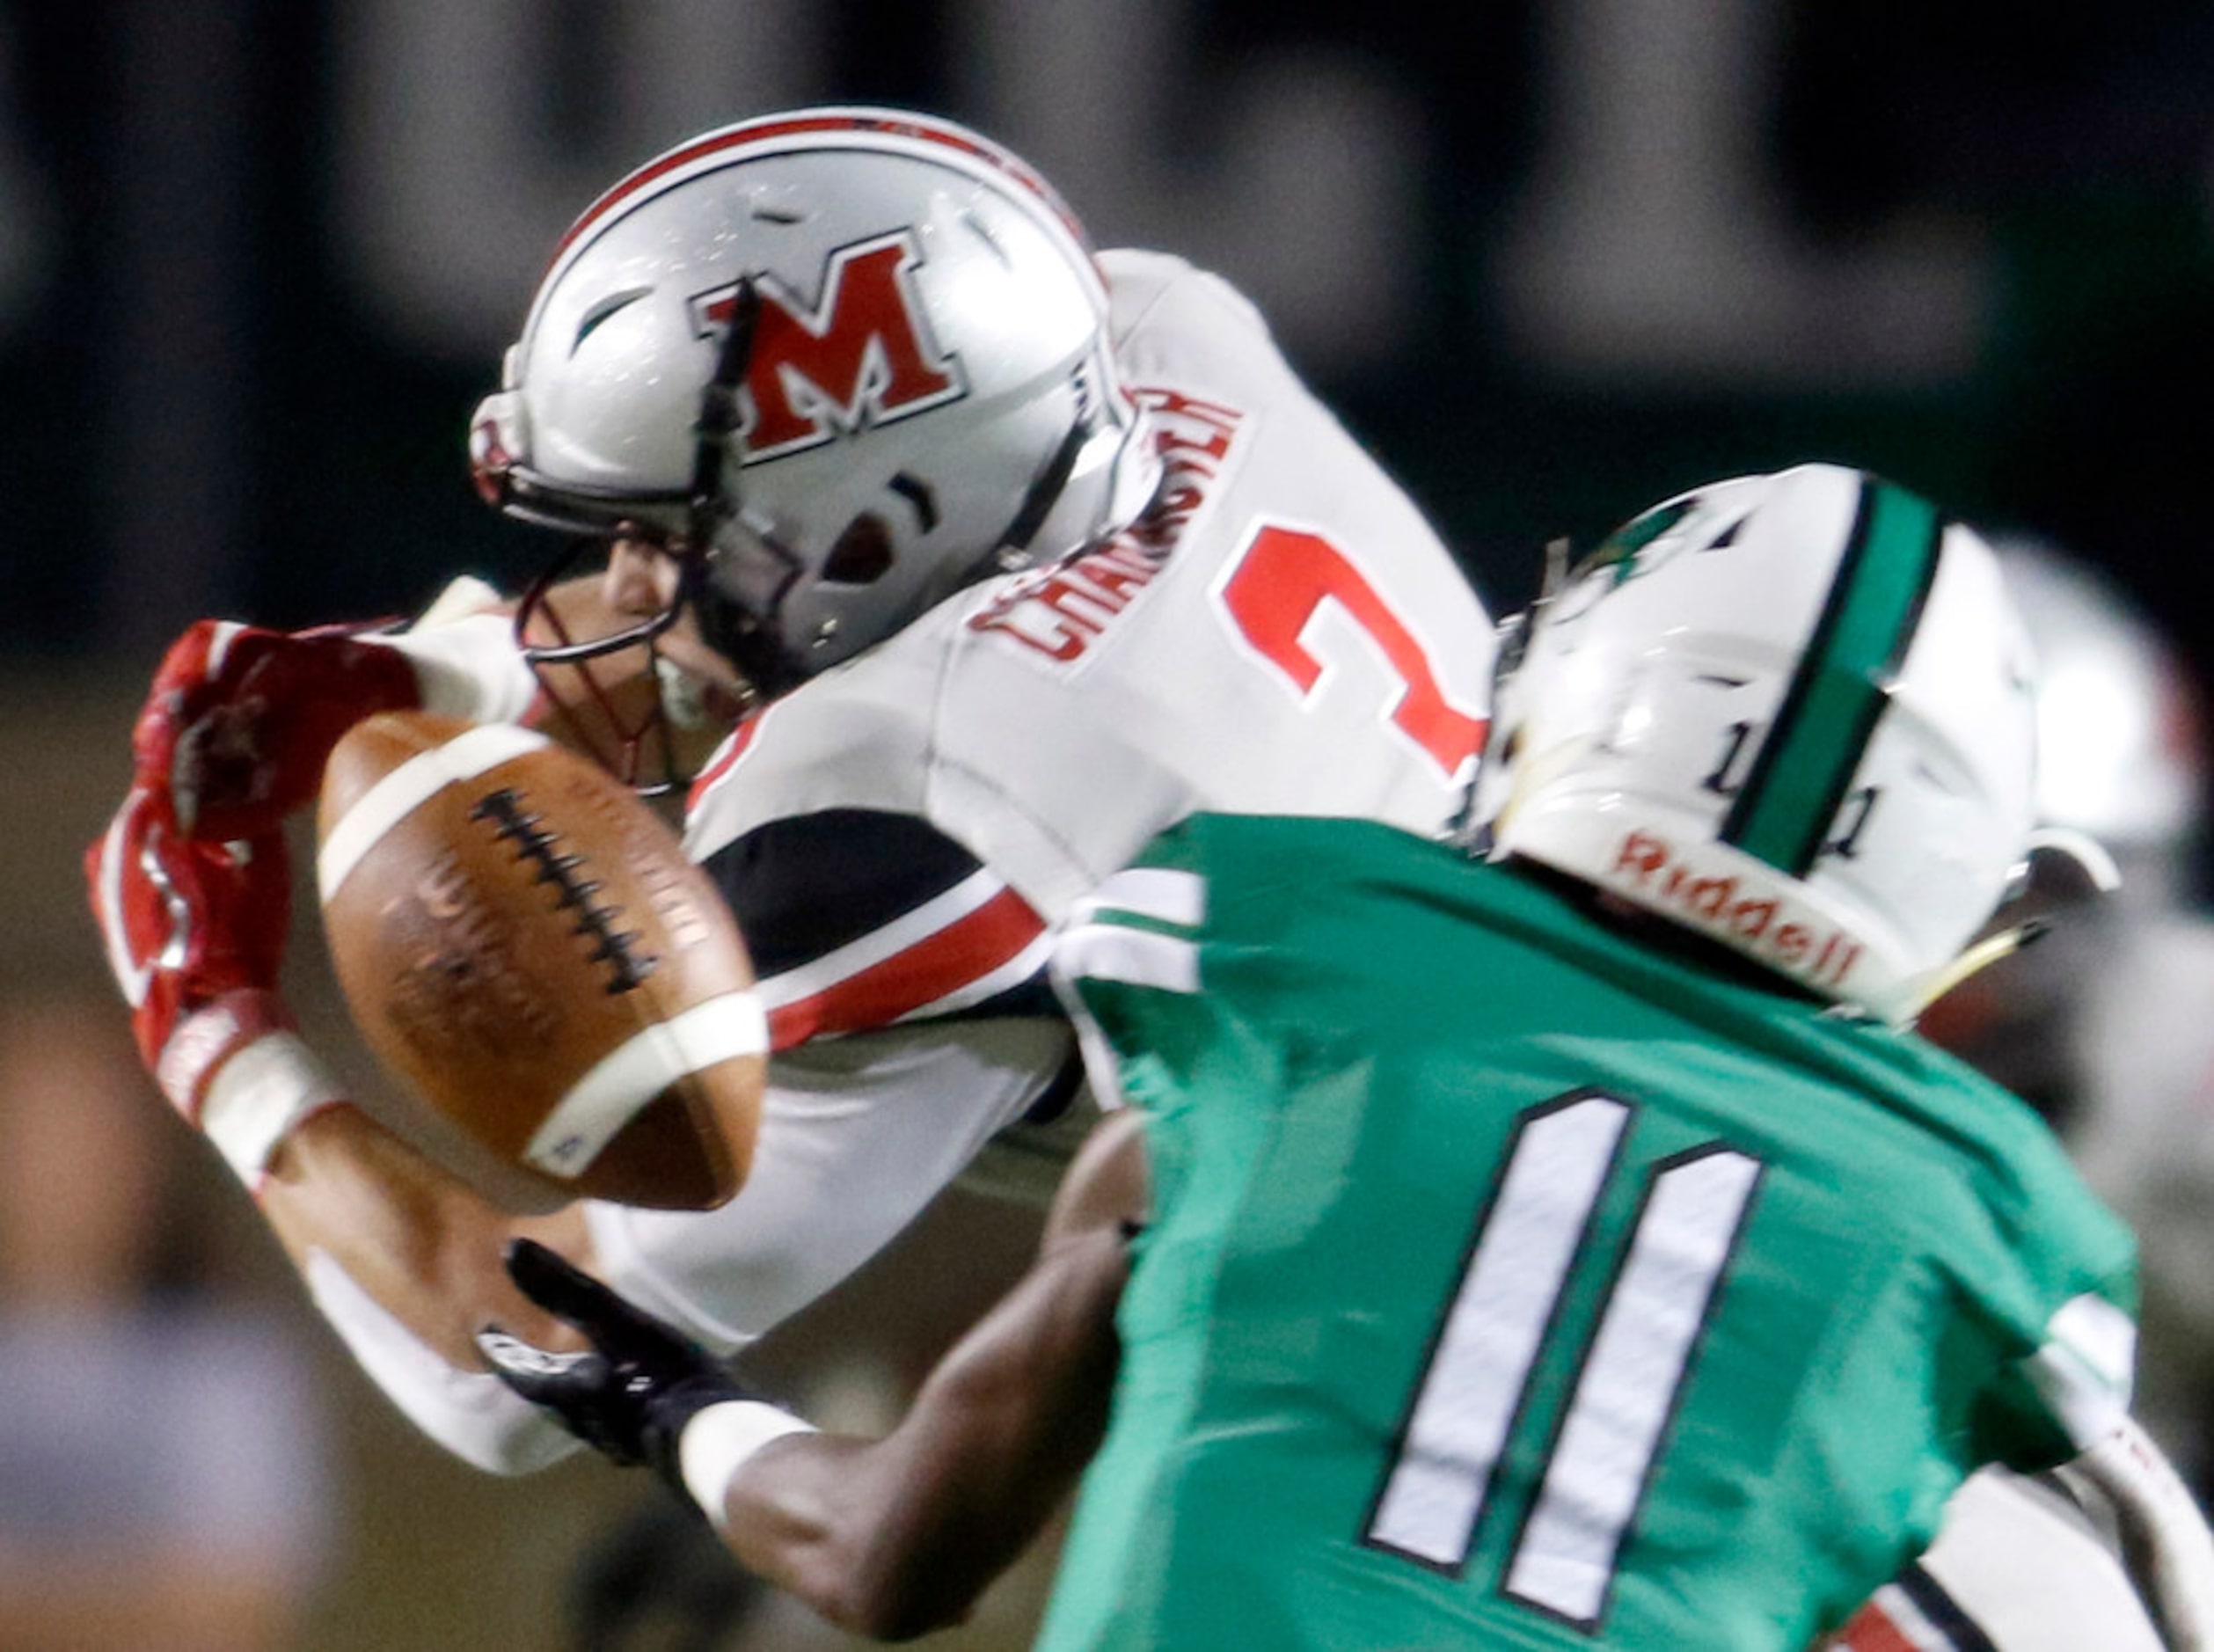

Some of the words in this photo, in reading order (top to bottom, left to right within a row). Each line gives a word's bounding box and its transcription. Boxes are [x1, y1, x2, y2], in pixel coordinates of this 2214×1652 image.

[688, 225, 970, 468] M
[1617, 827, 1867, 985] Riddell
[1360, 1084, 1766, 1638] 11
